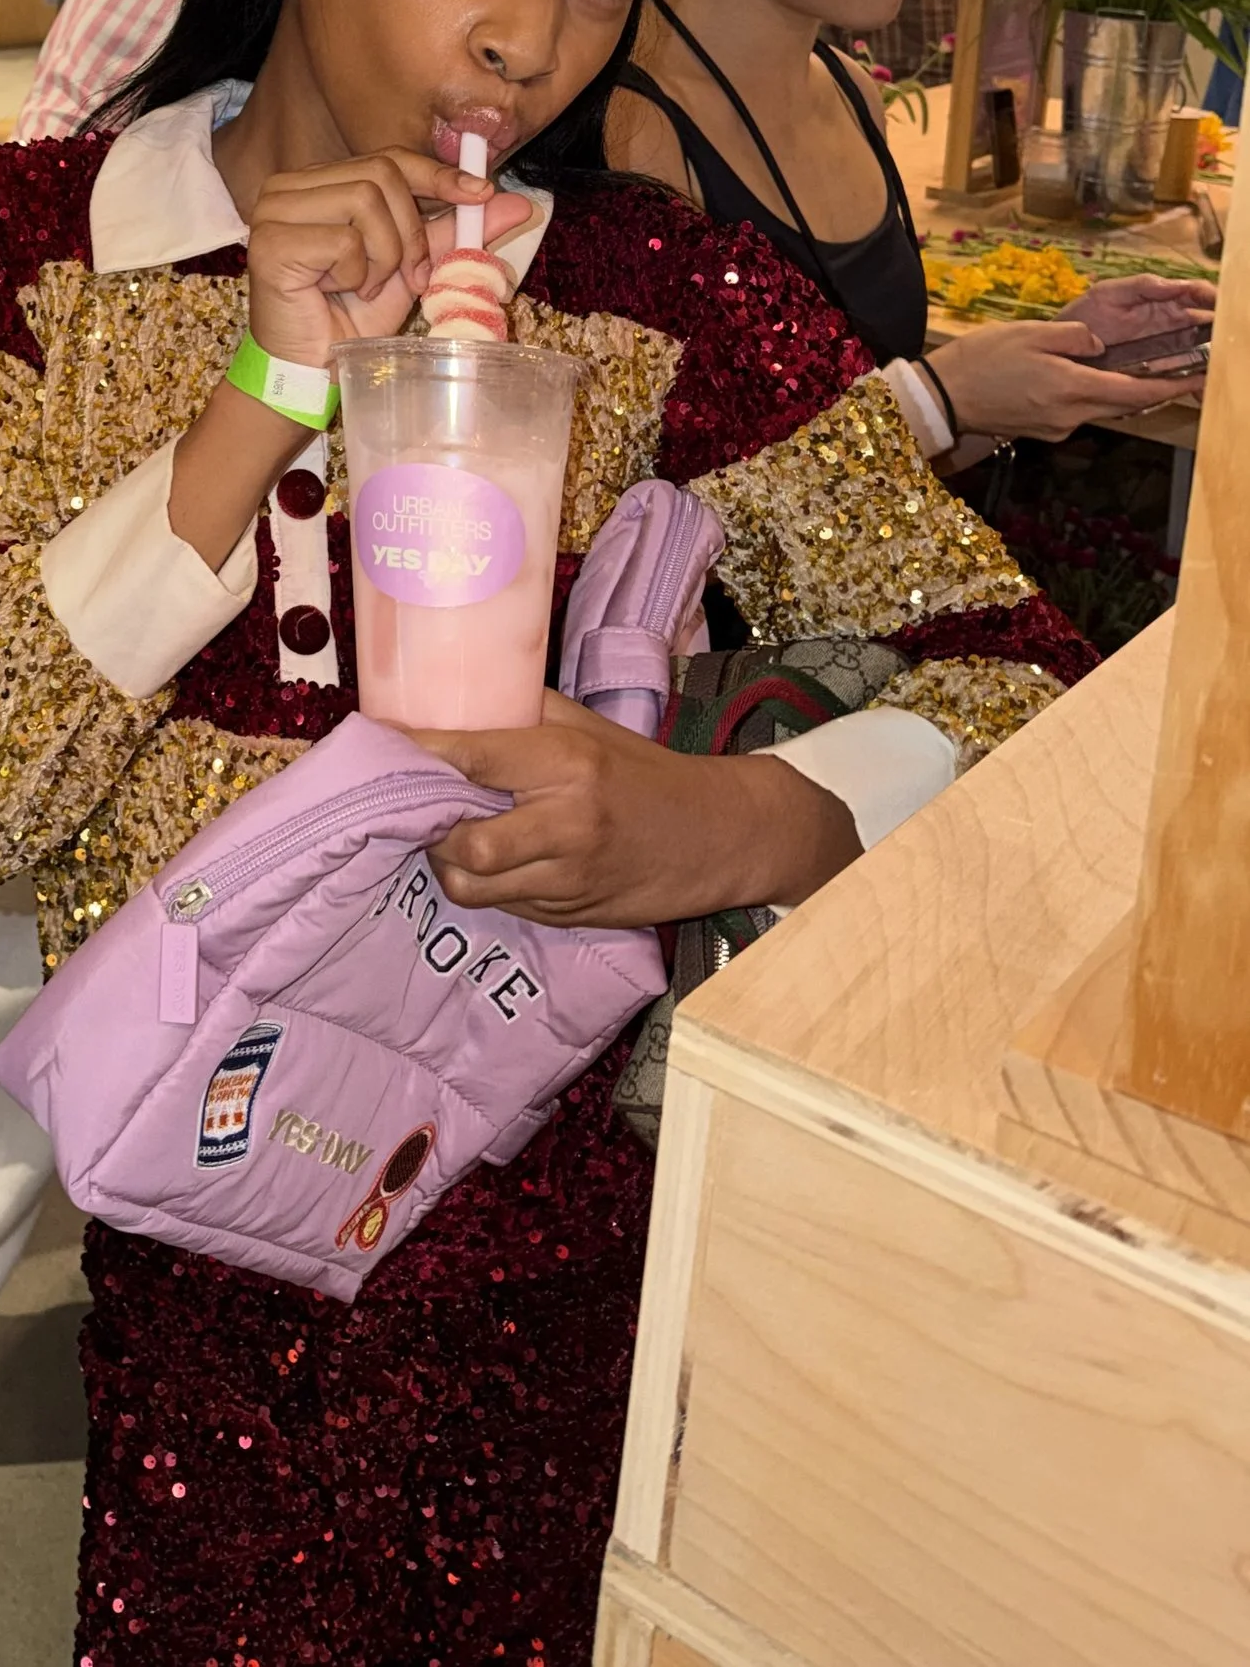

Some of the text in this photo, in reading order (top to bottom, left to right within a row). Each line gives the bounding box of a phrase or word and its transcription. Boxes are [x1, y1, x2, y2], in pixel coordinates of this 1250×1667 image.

[393, 494, 463, 519] URBAN
[372, 510, 492, 540] OUTFITTERS
[371, 544, 492, 576] YES DAY
[370, 865, 545, 1025] BROOKE
[267, 1108, 375, 1175] YES DAY
